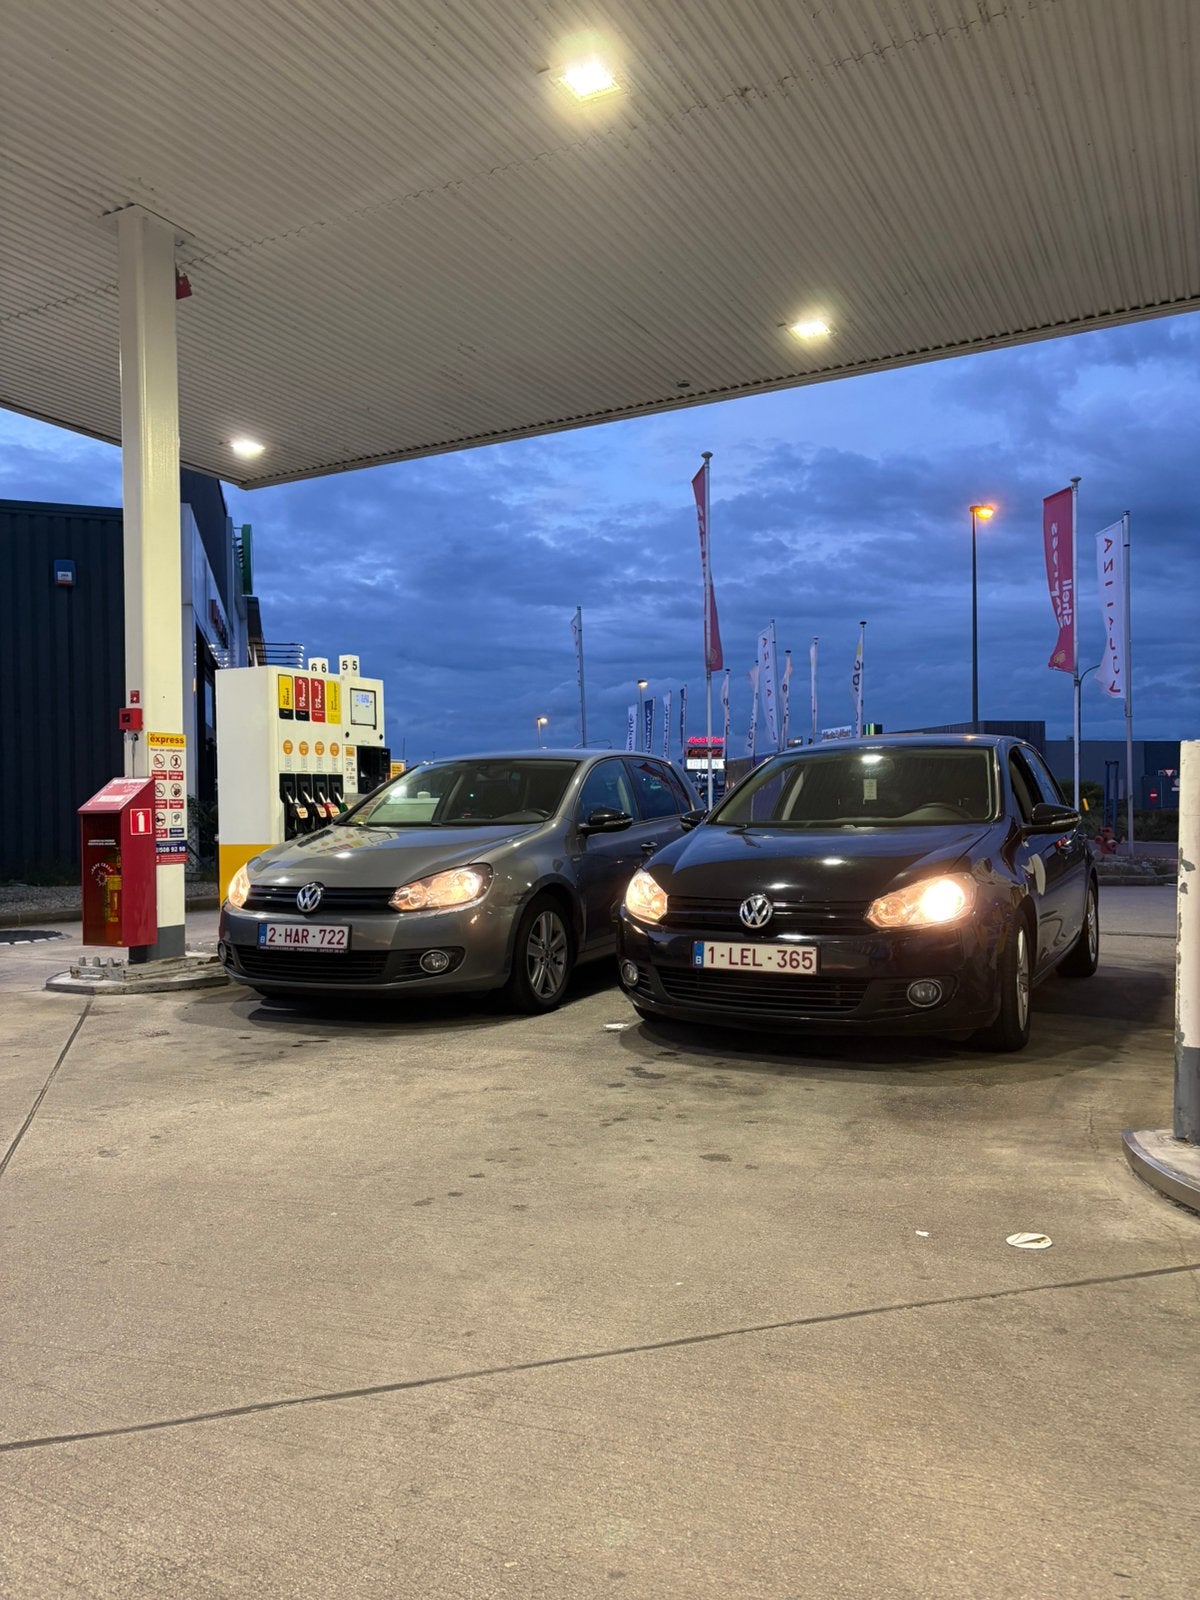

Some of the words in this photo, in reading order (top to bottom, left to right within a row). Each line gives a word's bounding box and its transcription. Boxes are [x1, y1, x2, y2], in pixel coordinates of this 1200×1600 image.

[311, 663, 317, 672] 6
[322, 664, 326, 672] 6
[342, 660, 348, 670] 5
[352, 660, 358, 670] 5
[695, 956, 702, 964] B
[708, 946, 814, 970] 1-LEL-365
